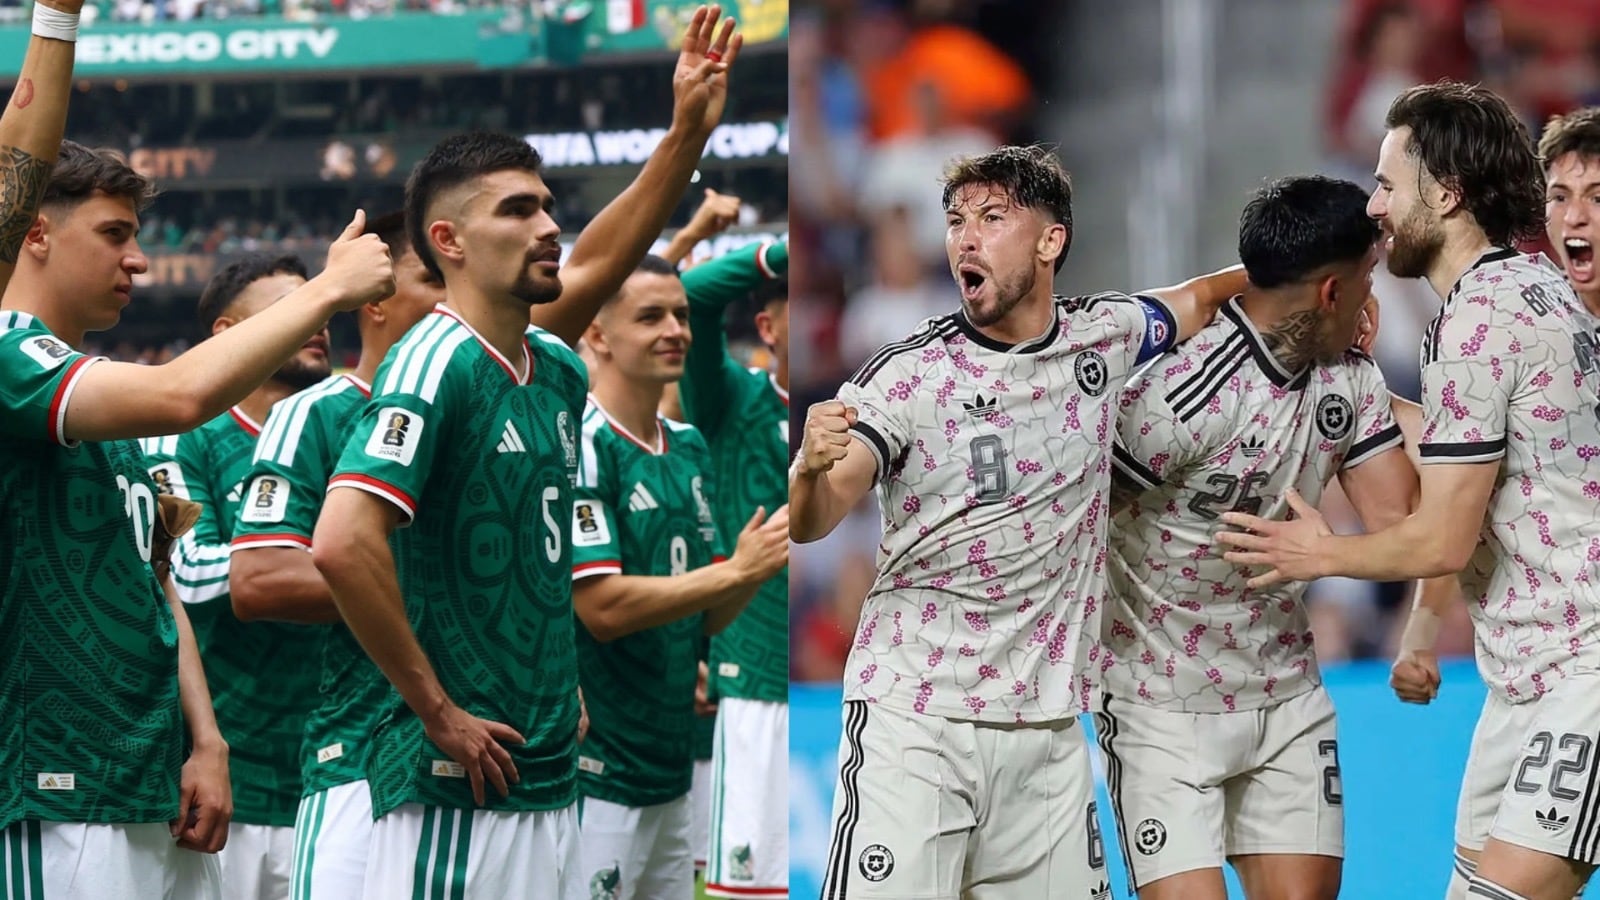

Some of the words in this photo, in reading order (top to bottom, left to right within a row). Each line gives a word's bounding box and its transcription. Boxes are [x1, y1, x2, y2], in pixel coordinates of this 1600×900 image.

[76, 32, 222, 63] EXICO
[225, 28, 338, 60] CITY
[969, 434, 1008, 501] 8
[1187, 471, 1271, 519] 26
[542, 486, 562, 563] 5
[1514, 731, 1593, 801] 22
